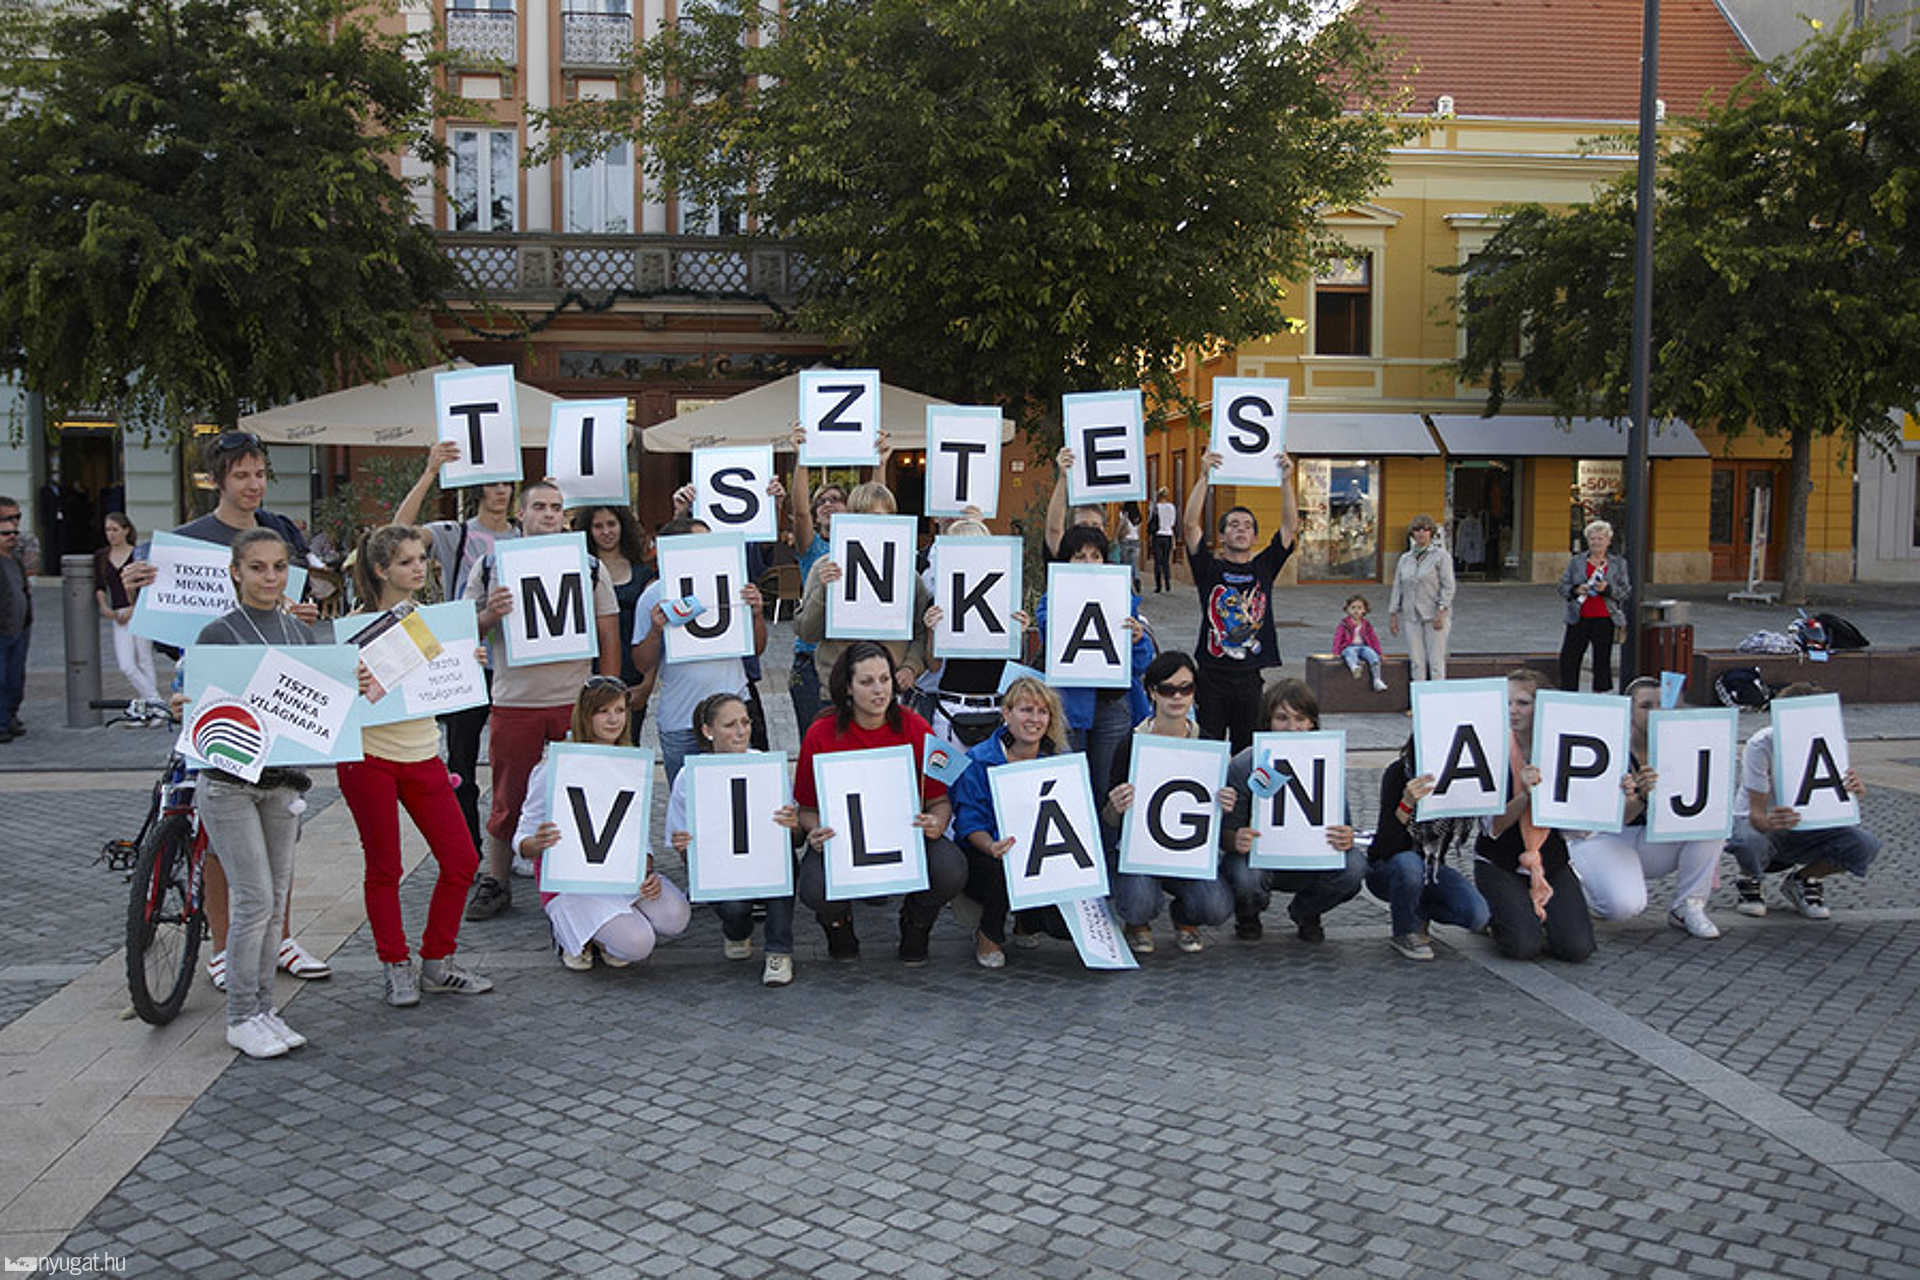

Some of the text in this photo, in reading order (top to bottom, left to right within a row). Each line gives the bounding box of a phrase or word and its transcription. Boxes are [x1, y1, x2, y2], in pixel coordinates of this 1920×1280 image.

[450, 385, 1274, 523] T I S Z T E S
[174, 563, 229, 578] TISZTES
[175, 579, 225, 594] MUNKA
[521, 541, 1121, 666] M U N K A
[272, 688, 319, 718] MUNKA
[278, 673, 331, 707] TISZTES
[250, 692, 332, 740] VILÁGNAPJA
[567, 725, 1850, 878] V I L Á G N A P J A
